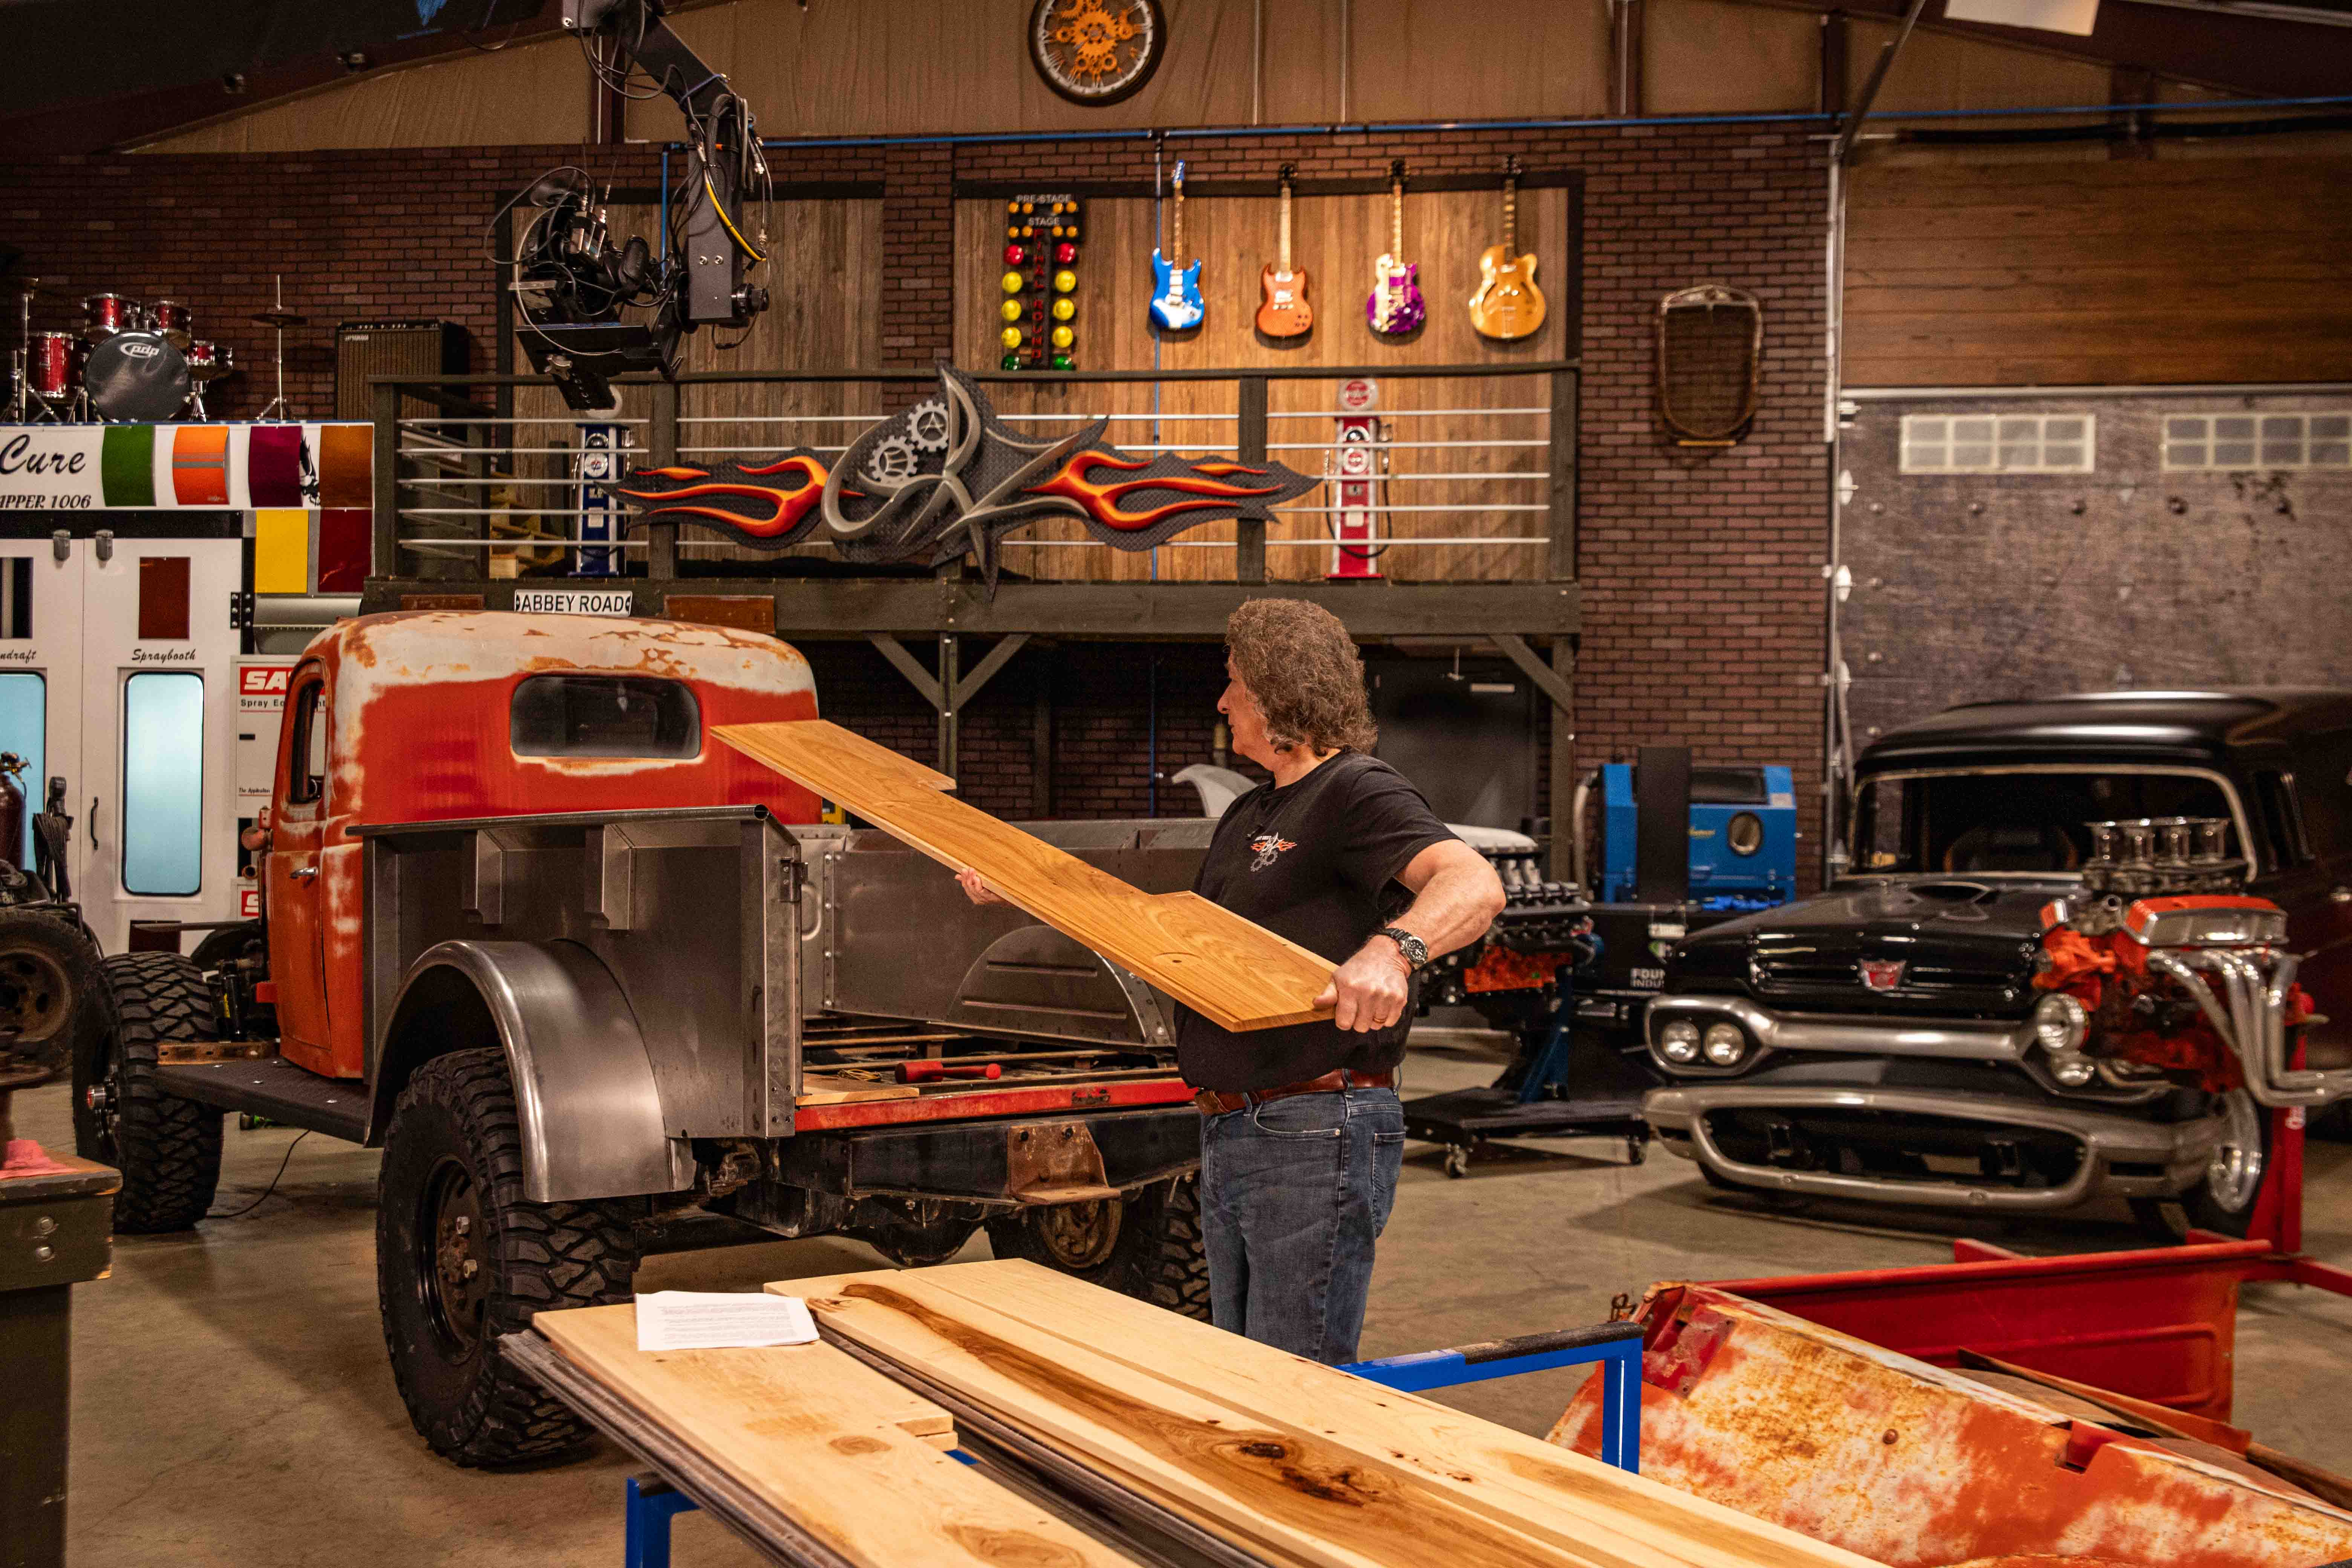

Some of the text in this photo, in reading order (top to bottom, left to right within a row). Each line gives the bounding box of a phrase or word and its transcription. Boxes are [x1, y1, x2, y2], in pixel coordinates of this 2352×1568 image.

[1028, 217, 1060, 226] STAGE
[1032, 299, 1043, 358] ROUND
[0, 434, 86, 475] Cure
[51, 494, 92, 508] 1006
[522, 594, 624, 612] ABBEY ROAD
[132, 648, 196, 664] Spraybooth
[244, 671, 292, 690] SA
[241, 698, 268, 707] Spray
